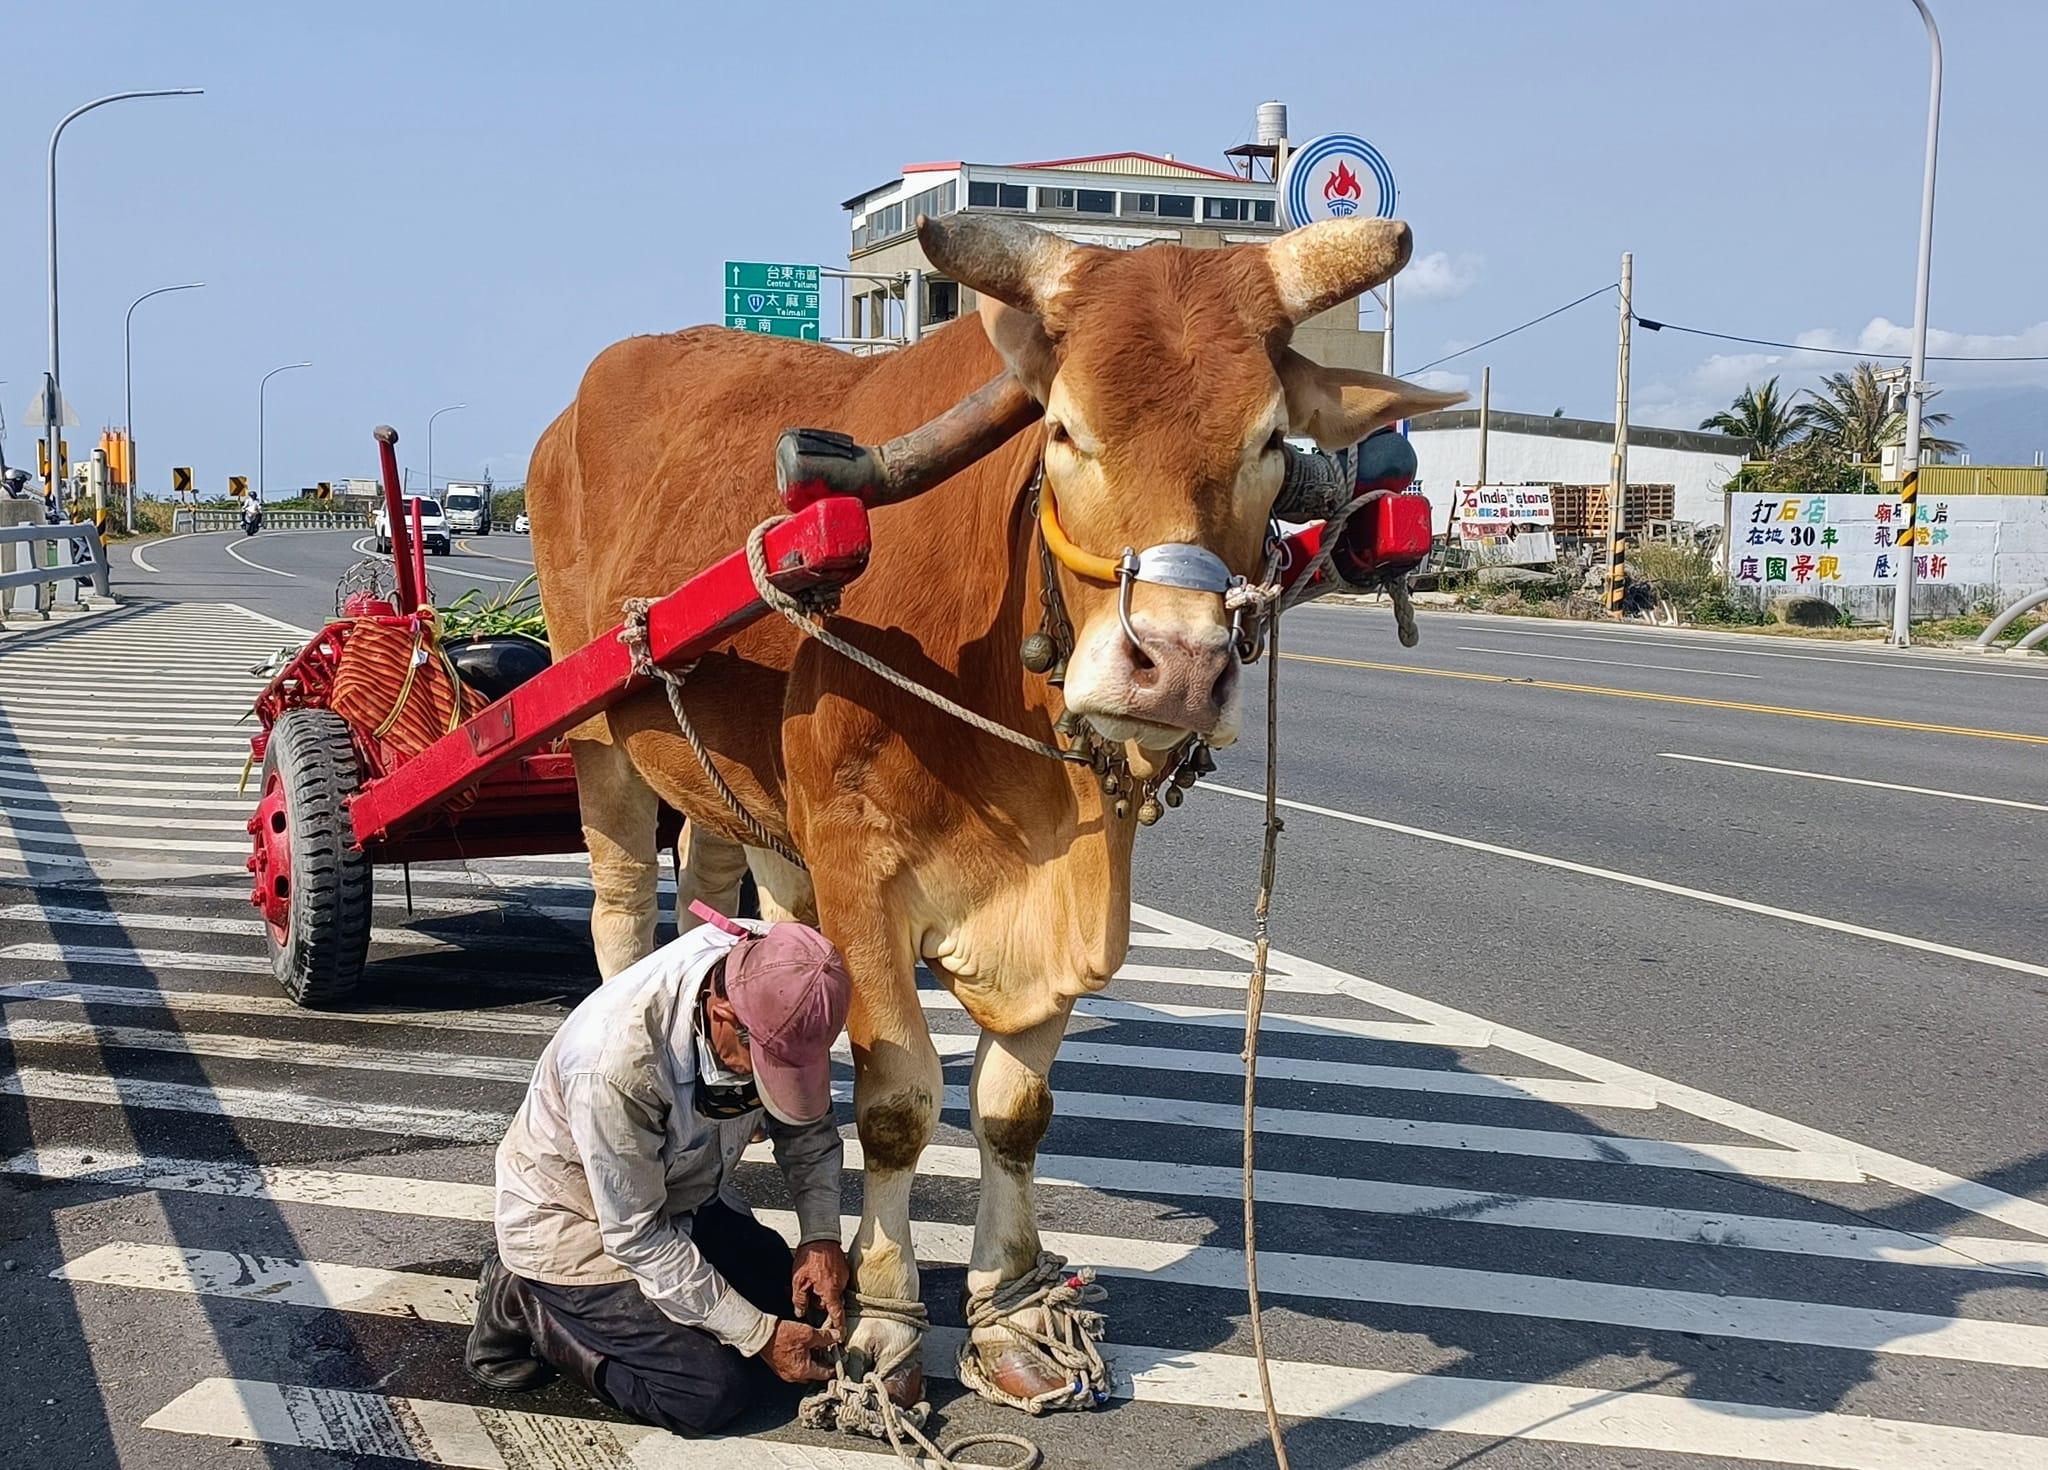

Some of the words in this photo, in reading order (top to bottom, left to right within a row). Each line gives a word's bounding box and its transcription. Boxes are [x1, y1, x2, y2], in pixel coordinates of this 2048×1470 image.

[766, 265, 817, 281] 台東市區
[766, 280, 790, 288] Central
[793, 281, 817, 290] Taitung
[752, 297, 760, 306] 11
[766, 293, 818, 309] 太麻里
[776, 308, 806, 317] Taimali
[1480, 489, 1507, 504] India
[1750, 496, 1826, 524] 打石店
[1736, 554, 1841, 584] 庭園景觀
